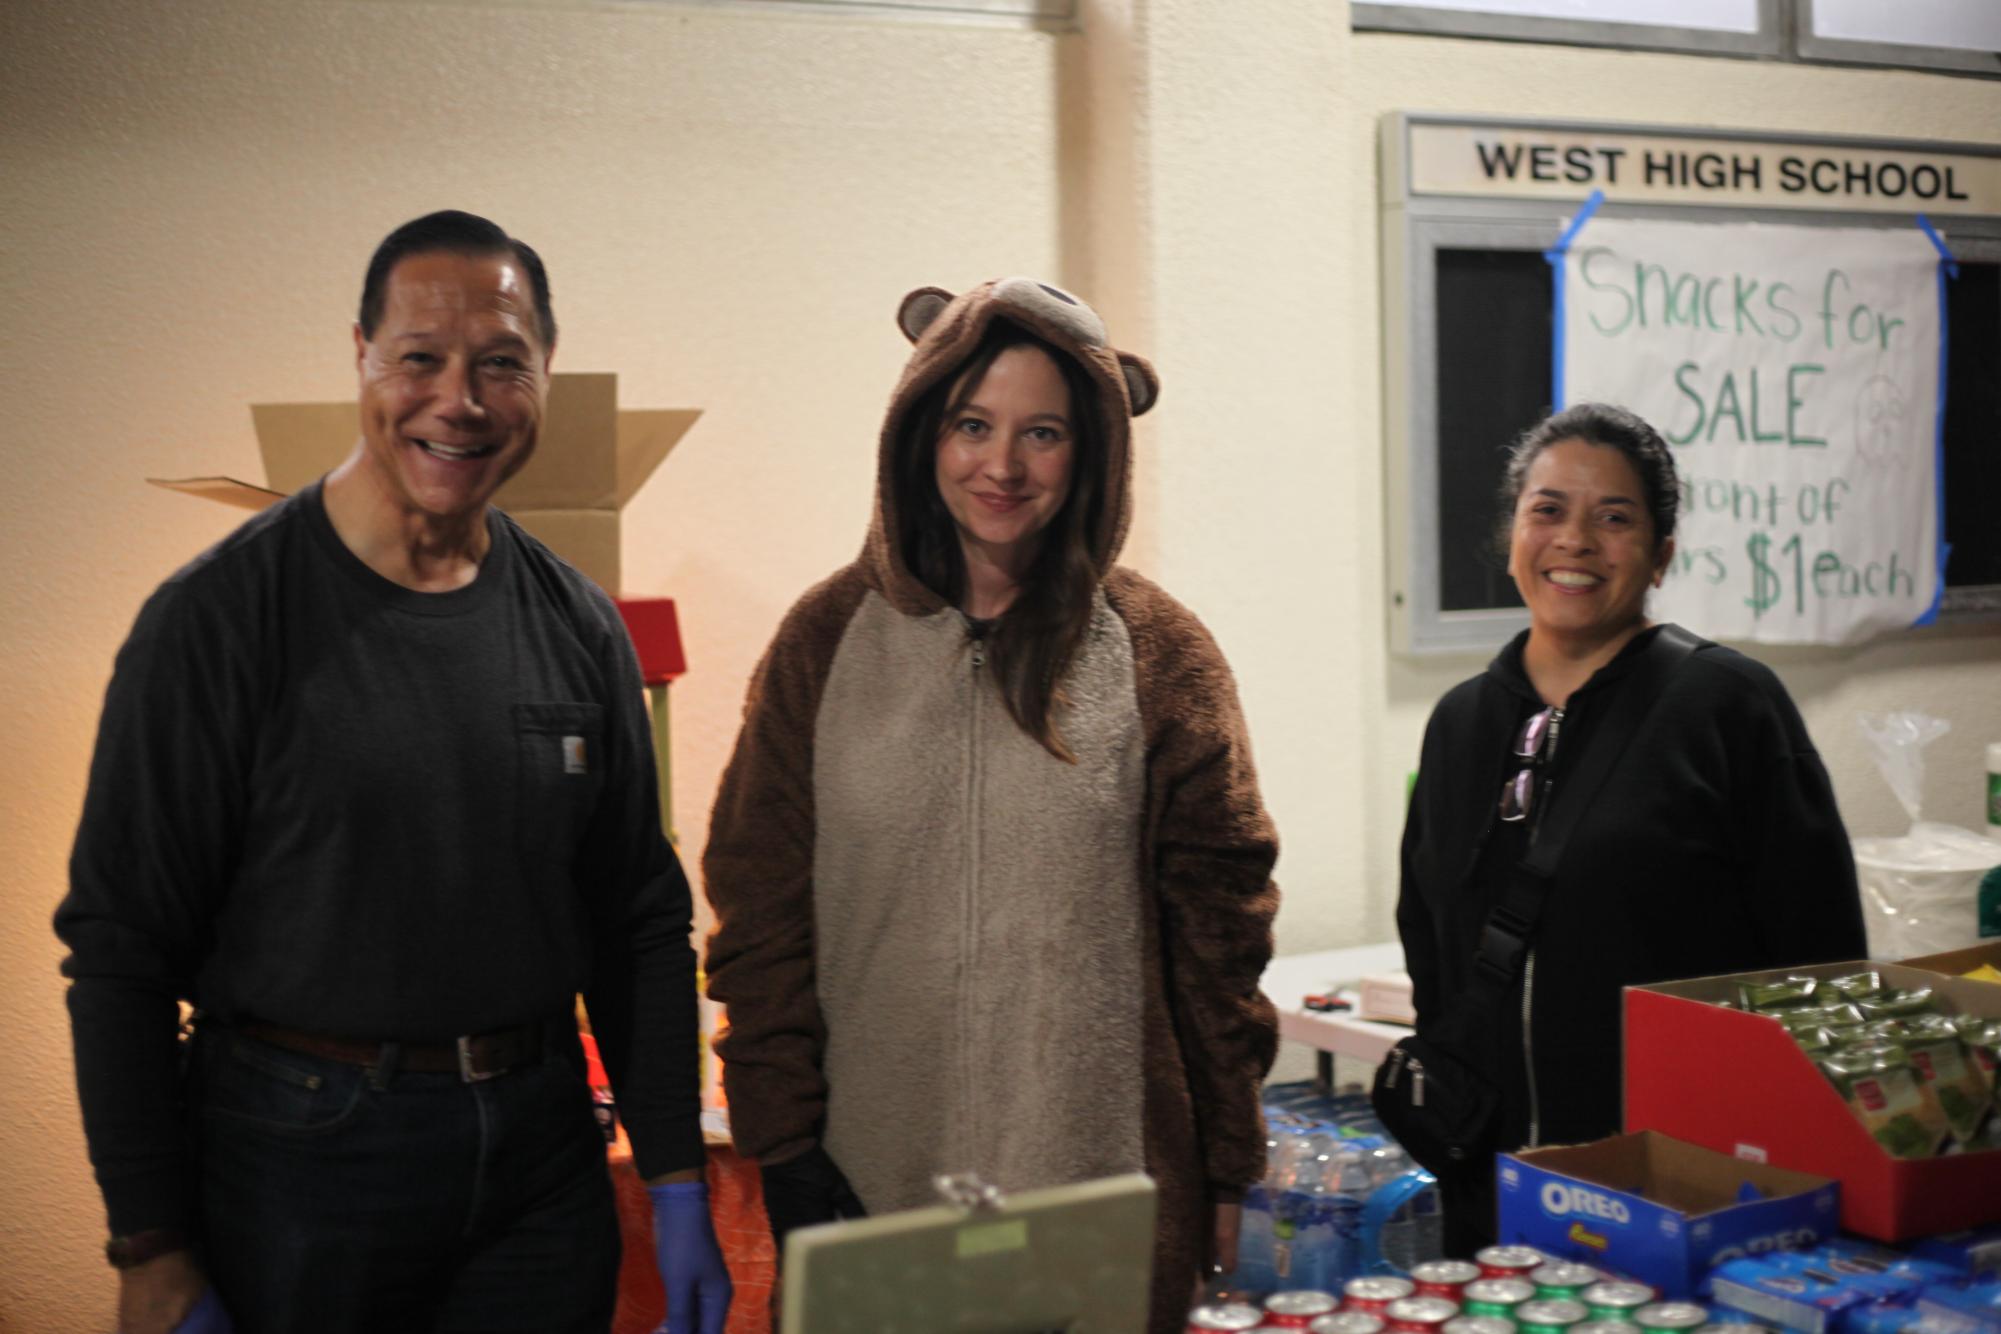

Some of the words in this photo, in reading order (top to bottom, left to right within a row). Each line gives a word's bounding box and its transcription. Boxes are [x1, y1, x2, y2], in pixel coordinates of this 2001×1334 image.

[1476, 142, 1627, 184] WEST
[1643, 151, 1764, 190] HIGH
[1779, 158, 1969, 200] SCHOOL
[1581, 247, 1800, 342] Snacks
[1818, 269, 1905, 349] for
[1664, 362, 1828, 446] SALE
[1682, 474, 1786, 526] ront
[1797, 477, 1850, 524] of
[1811, 550, 1915, 599] each
[1541, 1182, 1630, 1224] OREO
